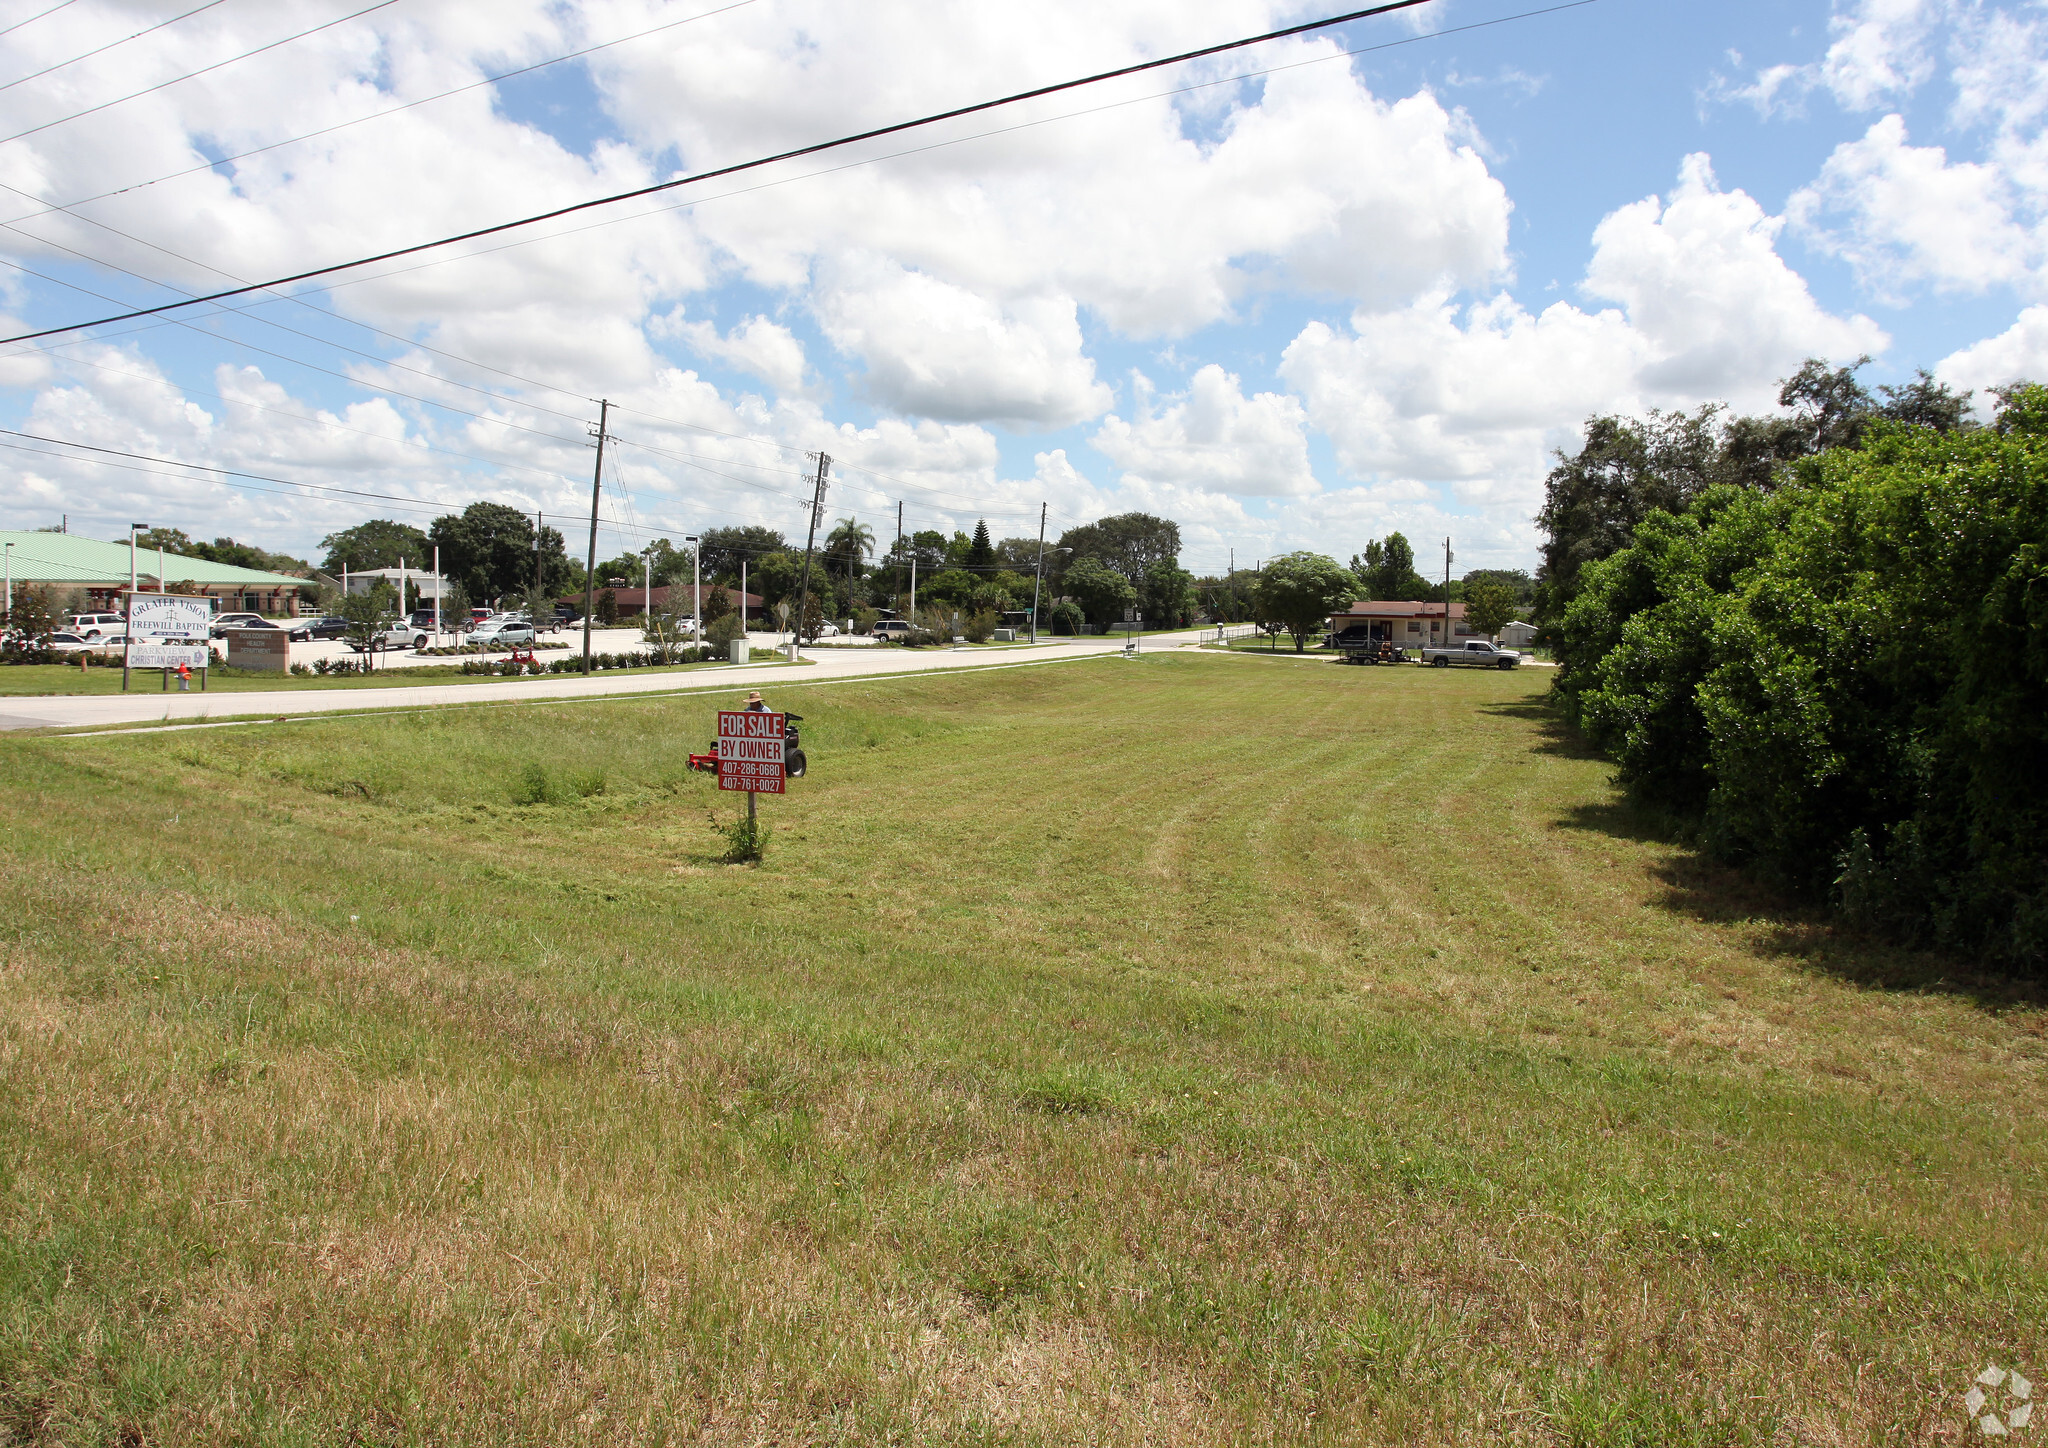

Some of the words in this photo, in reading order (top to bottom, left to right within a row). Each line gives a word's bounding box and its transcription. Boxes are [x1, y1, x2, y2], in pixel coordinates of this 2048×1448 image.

[132, 598, 176, 617] GREATER
[179, 599, 208, 620] VISION
[132, 620, 173, 630] FREEWILL
[176, 622, 208, 631] BAPTIST
[137, 647, 187, 655] PARKVIEW
[131, 655, 166, 664] CHRISTIAN
[167, 655, 191, 664] CENTER
[721, 715, 746, 736] FOR
[748, 716, 781, 737] SALE
[721, 739, 736, 757] BY
[739, 740, 781, 760] OWNER
[722, 762, 780, 776] 407-286-0680
[722, 778, 780, 792] 407-761-0027
